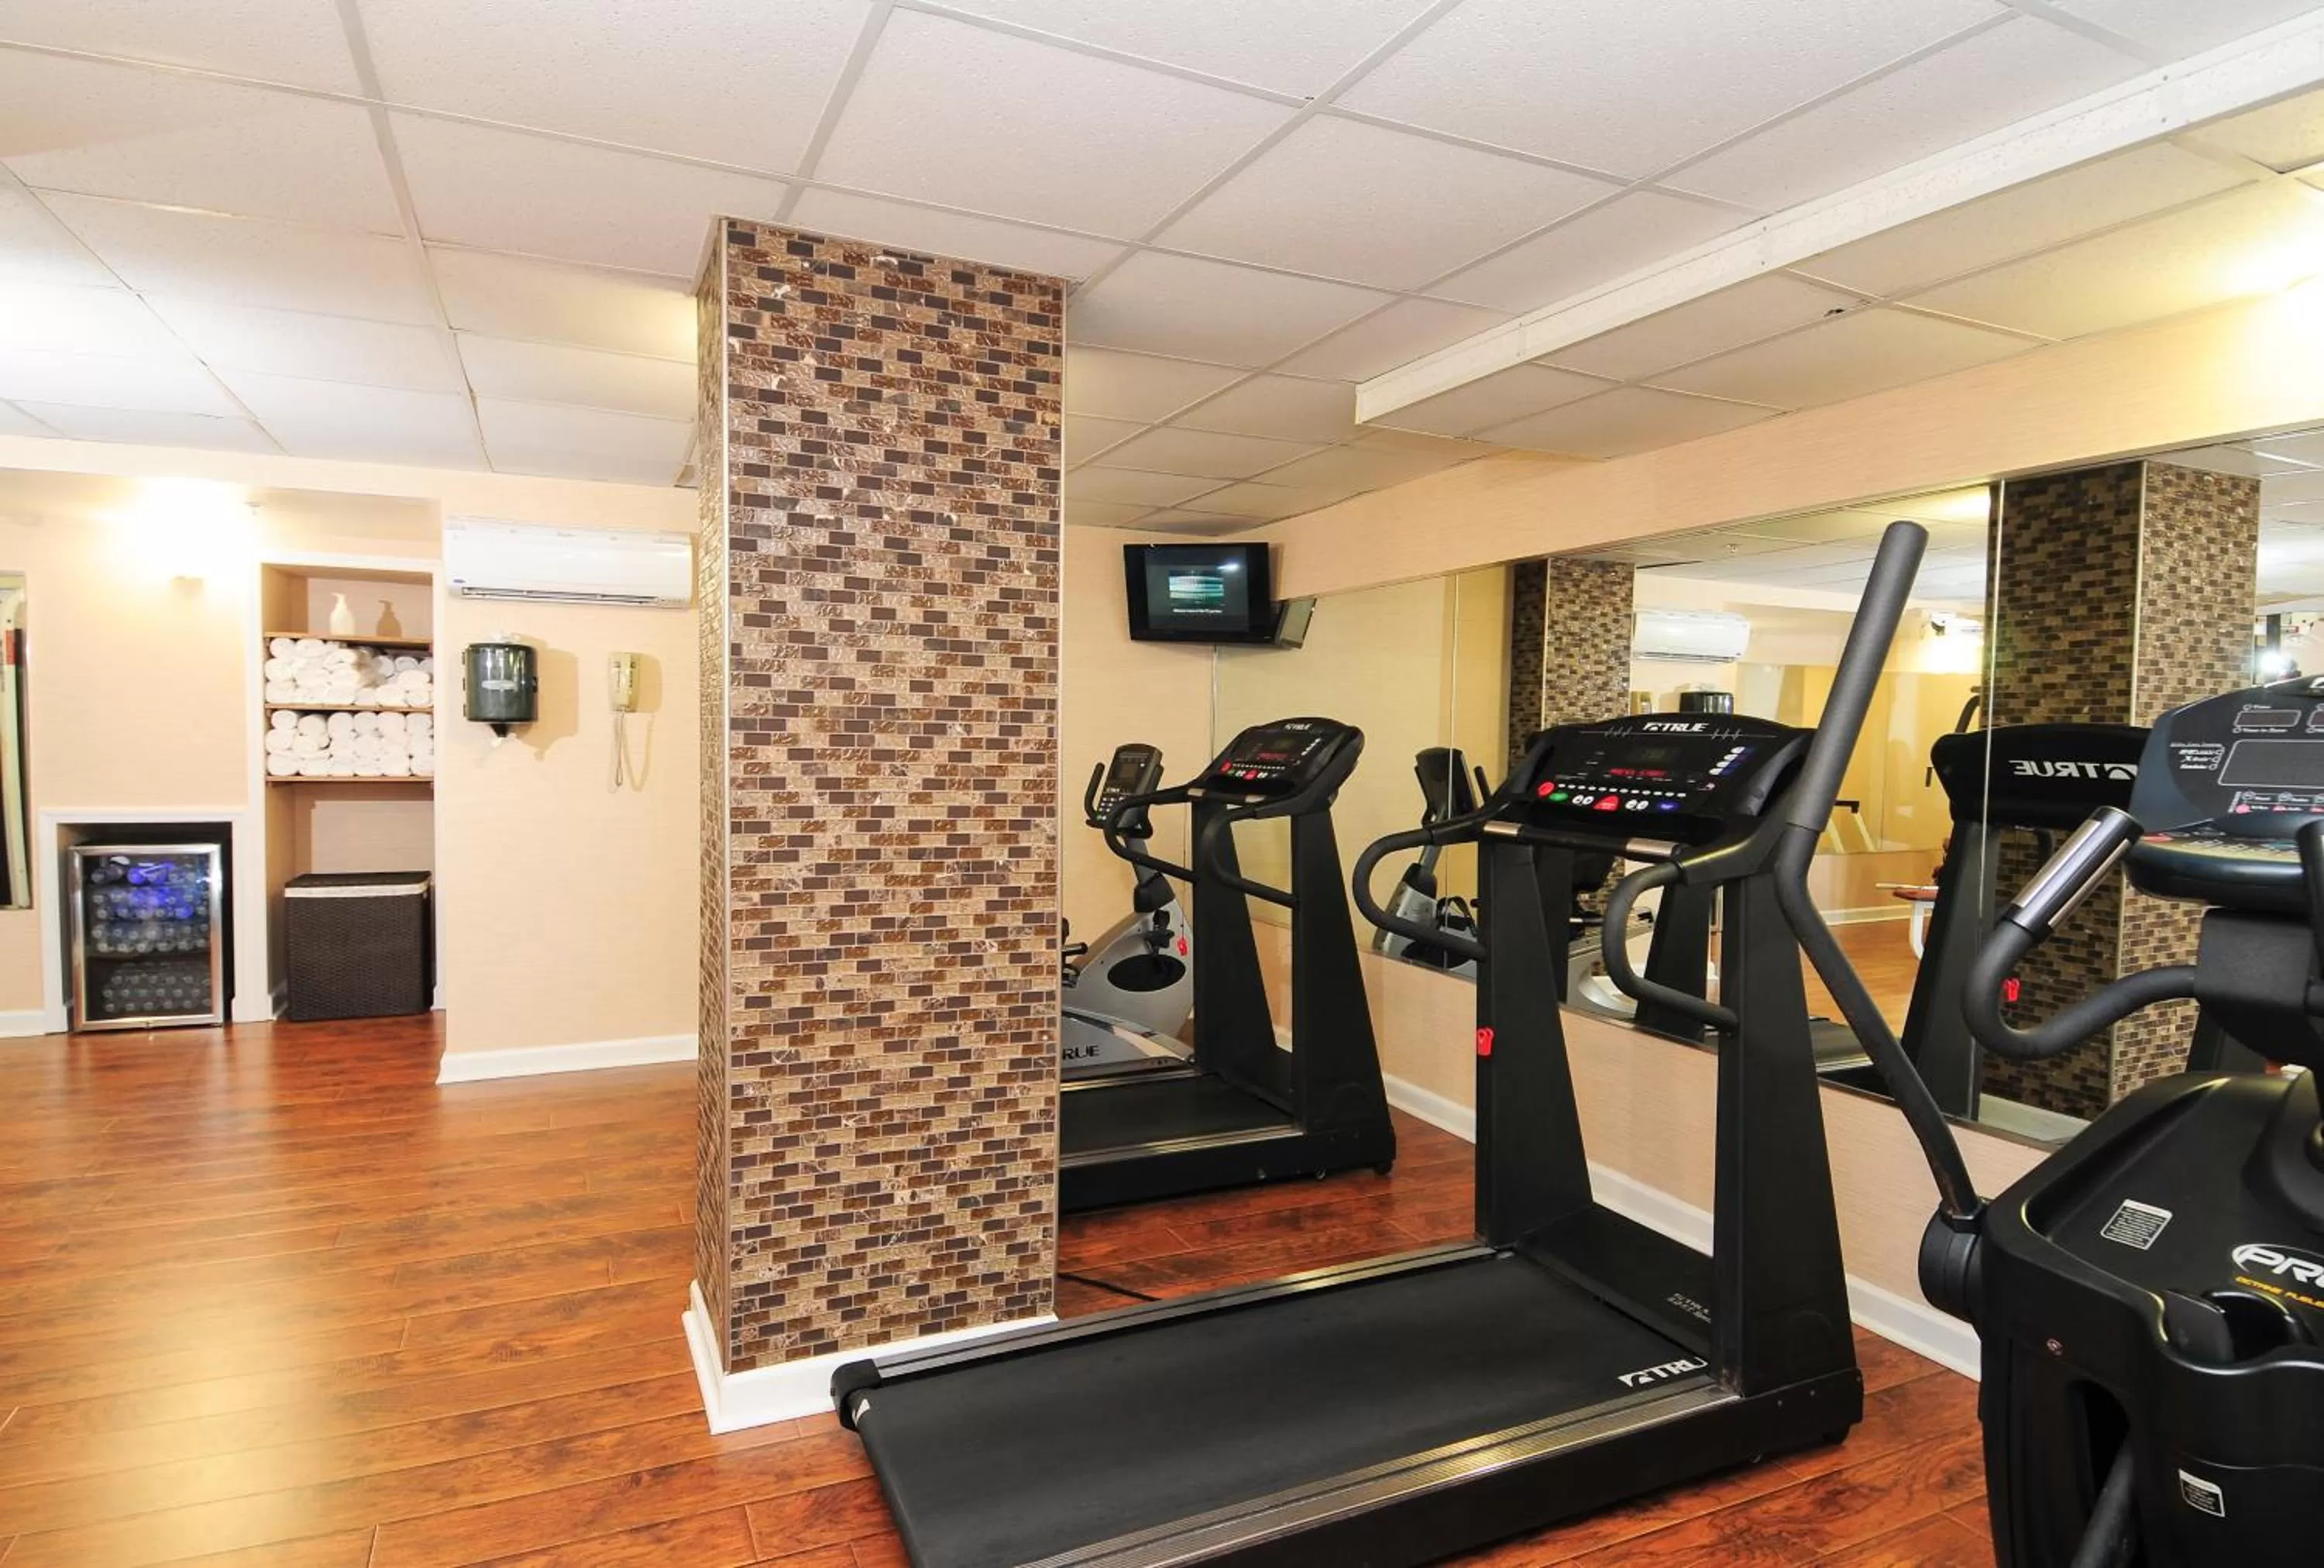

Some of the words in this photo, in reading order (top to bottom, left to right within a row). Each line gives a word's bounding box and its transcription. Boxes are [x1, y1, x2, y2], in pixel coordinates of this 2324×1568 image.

[1659, 722, 1710, 732] TRUE
[1062, 1044, 1100, 1060] RUE
[1648, 1357, 1709, 1378] TRU
